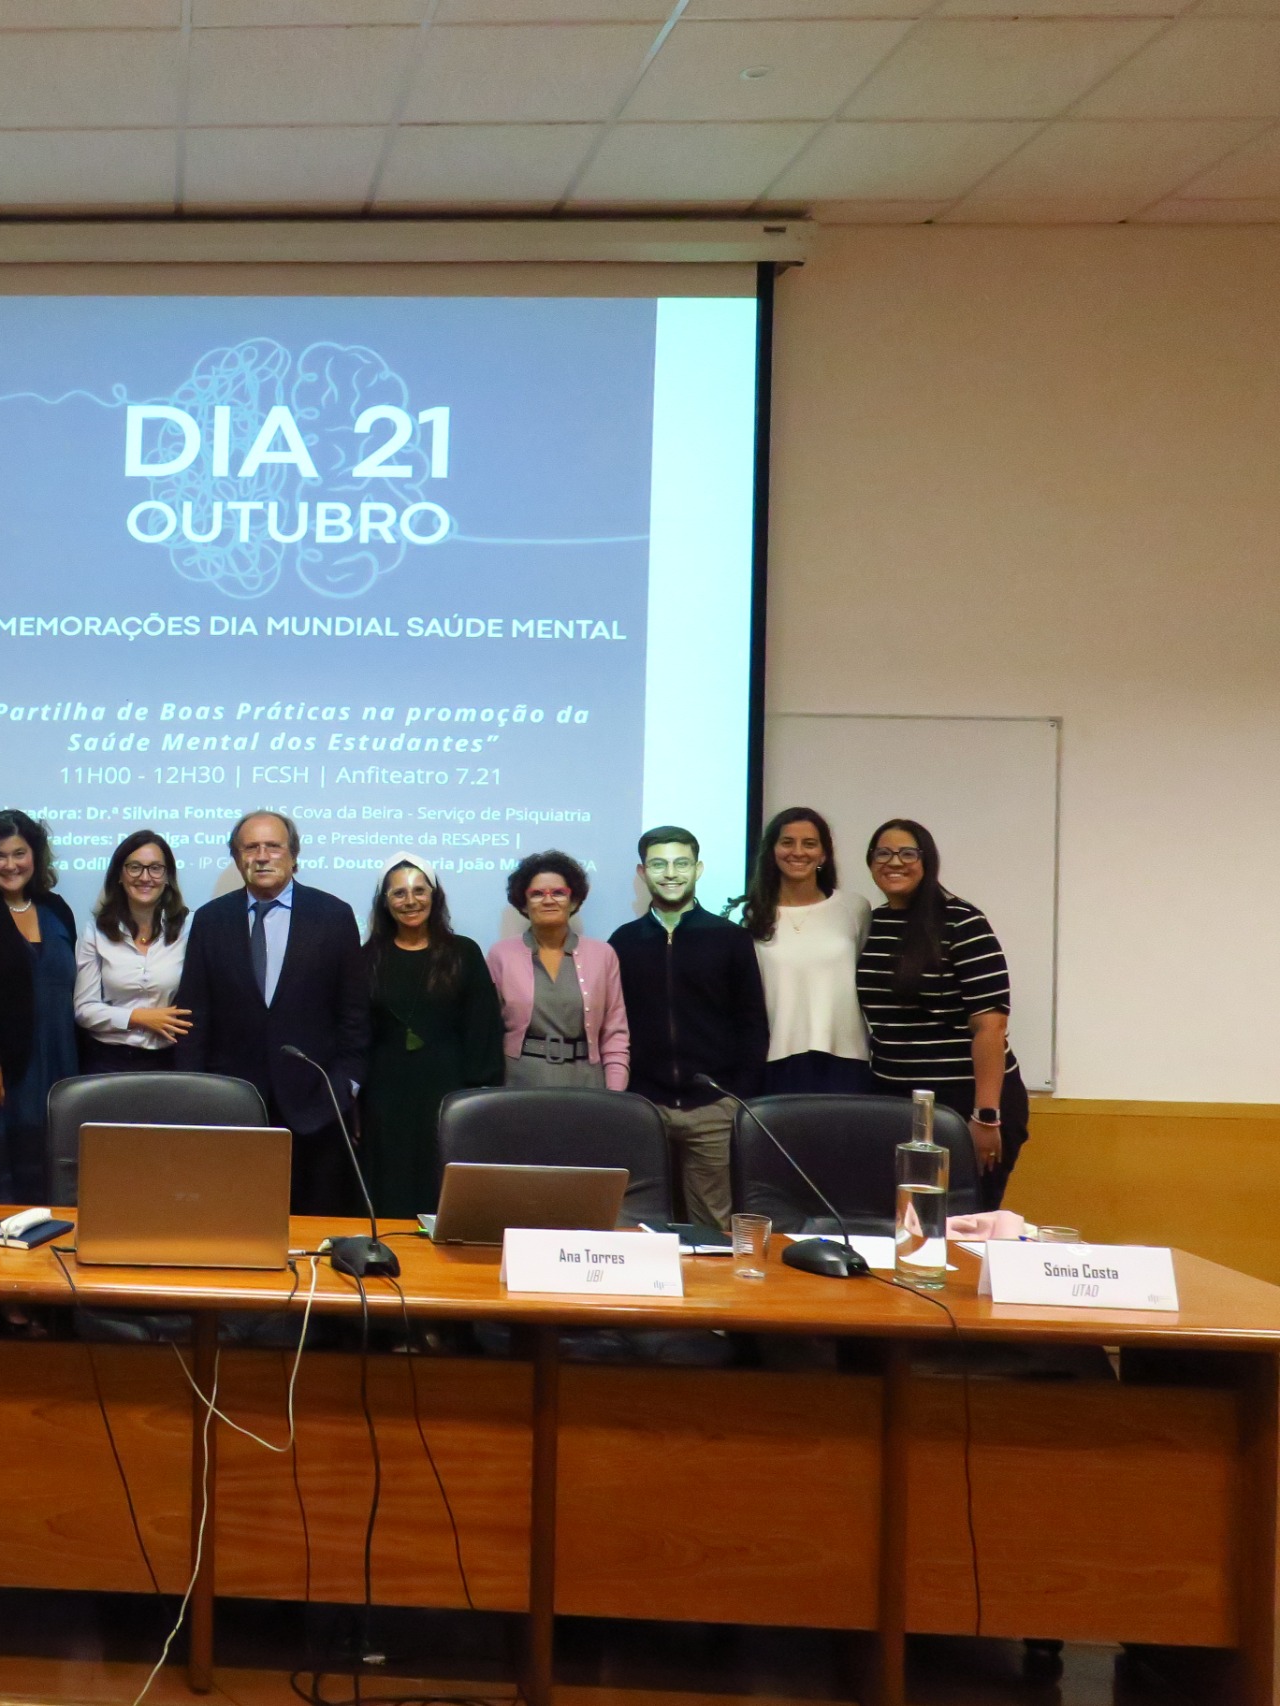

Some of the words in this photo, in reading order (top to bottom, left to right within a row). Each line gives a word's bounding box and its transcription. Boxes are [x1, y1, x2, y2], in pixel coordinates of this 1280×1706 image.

[122, 402, 321, 480] DIA
[351, 404, 451, 479] 21
[125, 500, 451, 545] OUTUBRO
[209, 615, 259, 636] DIA
[266, 616, 400, 637] MUNDIAL
[406, 613, 504, 638] SAÚDE
[511, 618, 627, 640] MENTAL
[116, 702, 149, 721] de
[159, 702, 225, 721] Boas
[236, 701, 351, 721] Práticas
[361, 706, 395, 721] na
[404, 703, 545, 728] promoção
[556, 705, 589, 724] da
[67, 732, 151, 752] Saúde
[161, 731, 260, 751] Mental
[269, 731, 317, 751] dos
[60, 766, 132, 785] 11H00
[154, 765, 225, 784] 12H30
[252, 765, 309, 784] FCSH
[335, 765, 449, 785] Anfiteatro
[455, 767, 500, 786] 7.21
[122, 806, 180, 820] Silvina
[184, 805, 243, 819] Fontes
[292, 805, 332, 819] Cova
[336, 805, 357, 819] da
[361, 805, 403, 820] Beira
[417, 806, 476, 824] Serviço
[480, 806, 501, 821] de
[505, 807, 591, 825] Psiquiatria
[47, 832, 113, 846] radores:
[194, 832, 231, 845] Cun
[317, 834, 327, 845] e
[331, 831, 414, 845] Presidente
[417, 832, 438, 846] da
[441, 832, 510, 846] RESAPES
[198, 856, 213, 869] IP
[296, 856, 328, 869] rof.
[332, 857, 384, 870] Douto
[456, 857, 495, 874] João
[559, 1248, 581, 1263] Ana
[584, 1248, 625, 1265] Torres
[1043, 1261, 1079, 1278] Sónia
[1082, 1263, 1119, 1280] Costa
